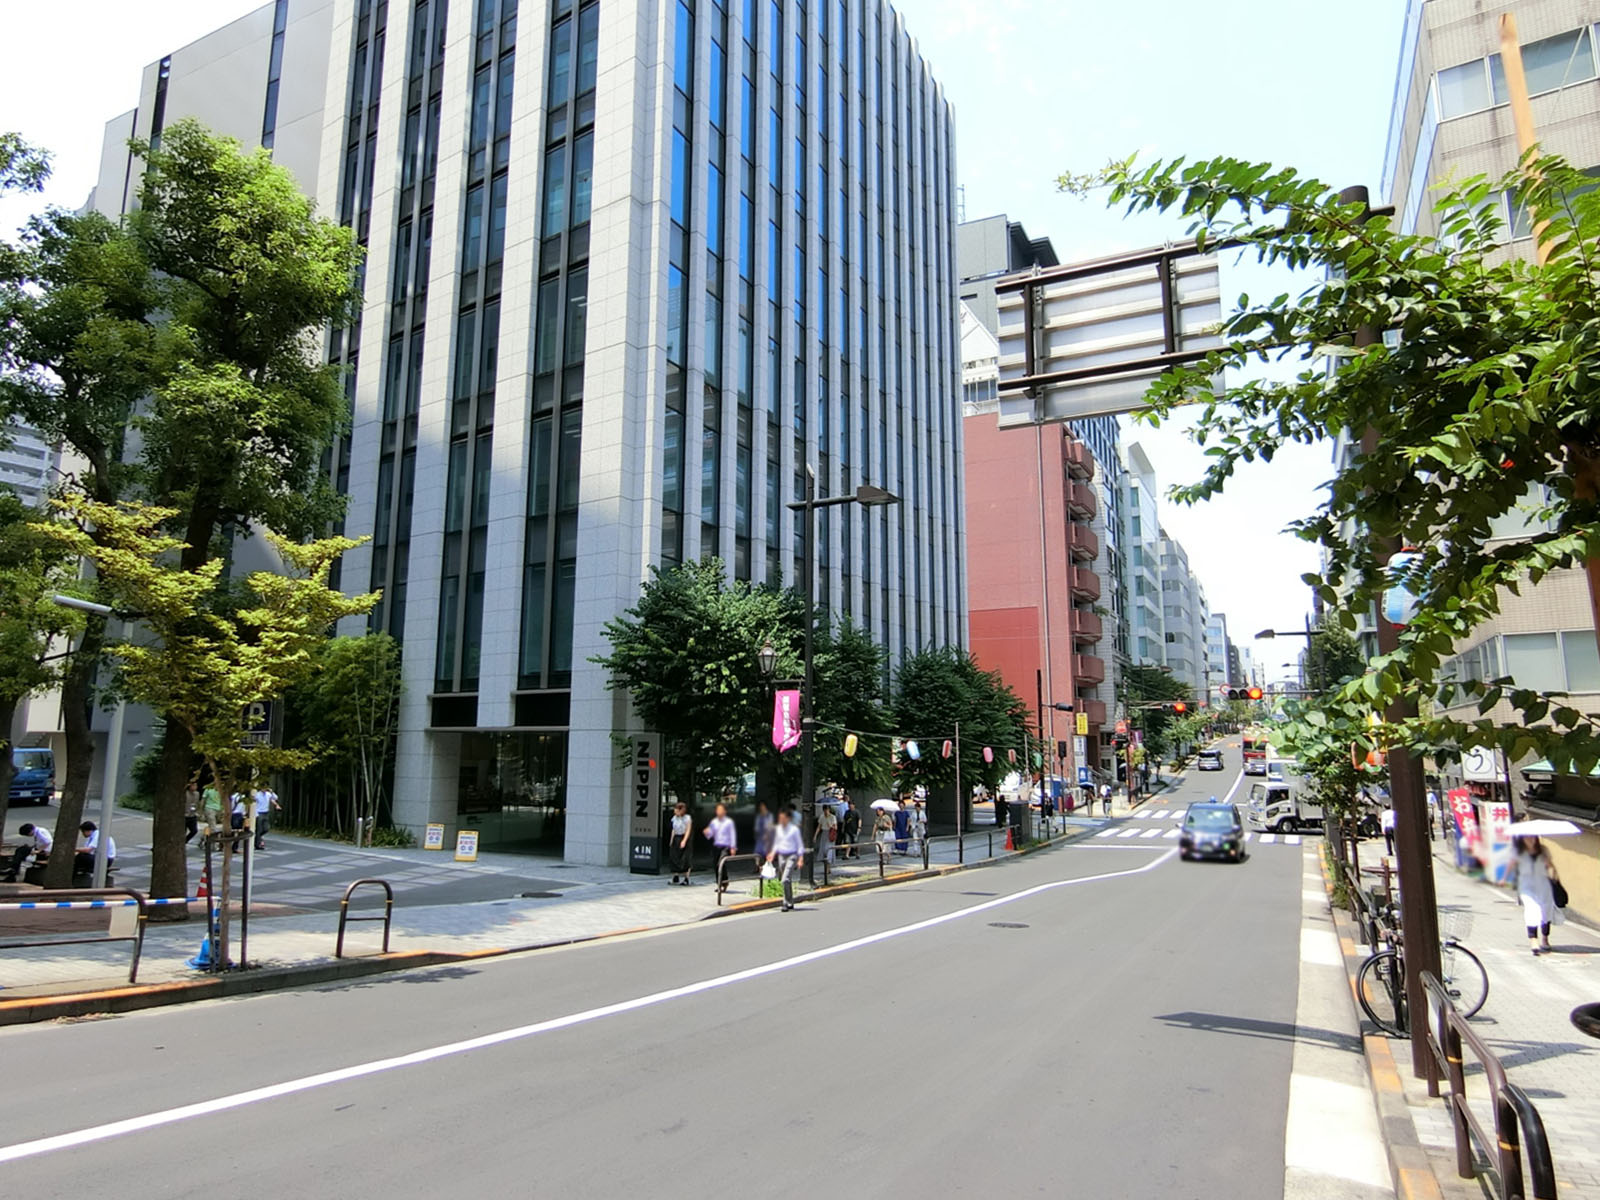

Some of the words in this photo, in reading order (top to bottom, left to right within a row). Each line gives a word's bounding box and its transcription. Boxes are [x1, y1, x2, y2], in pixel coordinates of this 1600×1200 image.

[248, 703, 264, 730] P
[636, 741, 654, 817] NIPPN
[641, 846, 652, 855] IN
